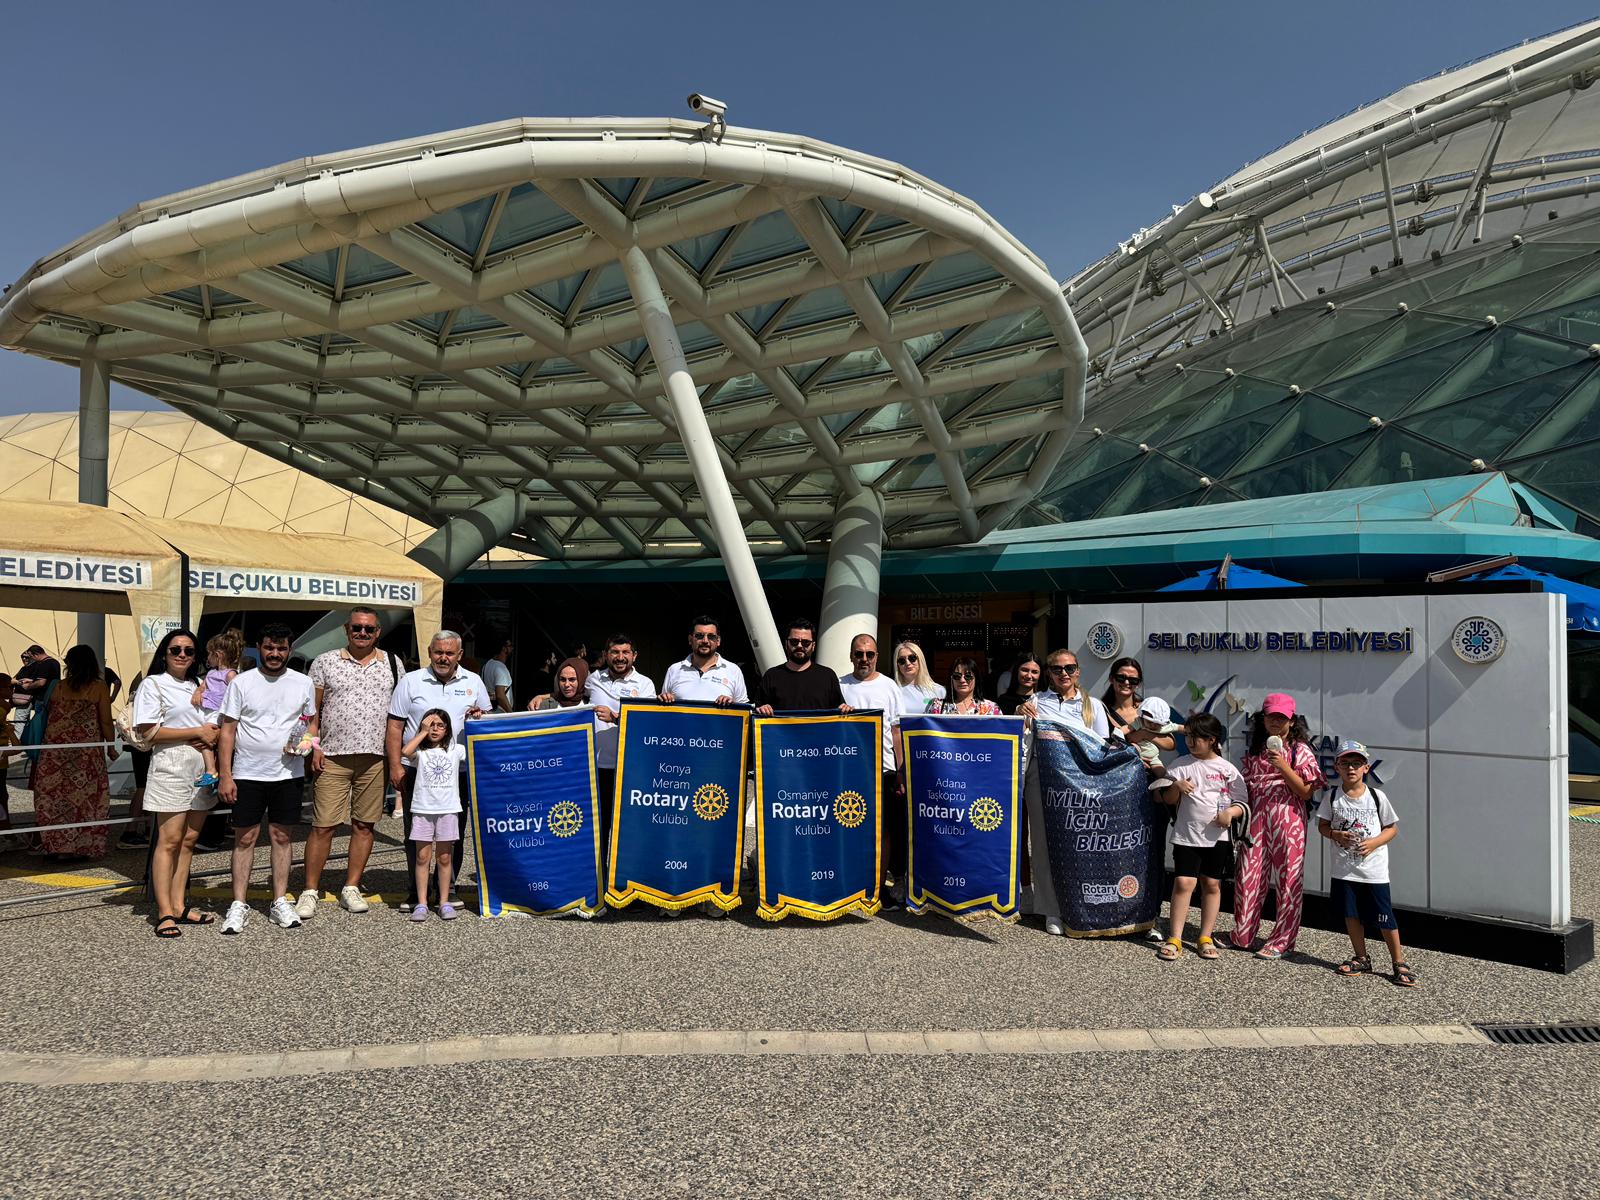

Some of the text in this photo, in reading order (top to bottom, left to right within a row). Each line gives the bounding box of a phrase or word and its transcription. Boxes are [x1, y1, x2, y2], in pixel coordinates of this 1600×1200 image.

[189, 570, 416, 601] SELÇUKLU BELEDİYESİ
[1148, 627, 1412, 653] SELÇUKLU BELEDİYESİ
[643, 736, 724, 749] UR 2430. BÖLGE
[780, 745, 858, 758] UR 2430. BÖLGE
[915, 750, 992, 762] UR 2430 BÖLGE
[500, 757, 563, 773] 2430. BÖLGE
[659, 762, 691, 776] Konya
[652, 778, 690, 790] Meram
[936, 778, 967, 789] Adana
[630, 789, 689, 811] Rotary
[777, 789, 829, 803] Osmaniye
[927, 789, 966, 803] Taşköprü
[1046, 786, 1103, 808] İYİLİK
[506, 801, 543, 816] Kayseri
[772, 802, 829, 821] Rotary
[919, 802, 965, 822] Rotary
[486, 816, 543, 834] Rotary
[652, 812, 689, 825] Kulübü
[1065, 809, 1108, 832] İÇİN
[795, 824, 831, 836] Kulübü
[933, 824, 966, 836] Kulübü
[508, 836, 545, 849] Kulübü
[664, 860, 688, 870] 2004
[811, 870, 835, 881] 2019
[943, 876, 966, 887] 2019
[527, 881, 549, 891] 1986
[1082, 883, 1118, 896] Rotary
